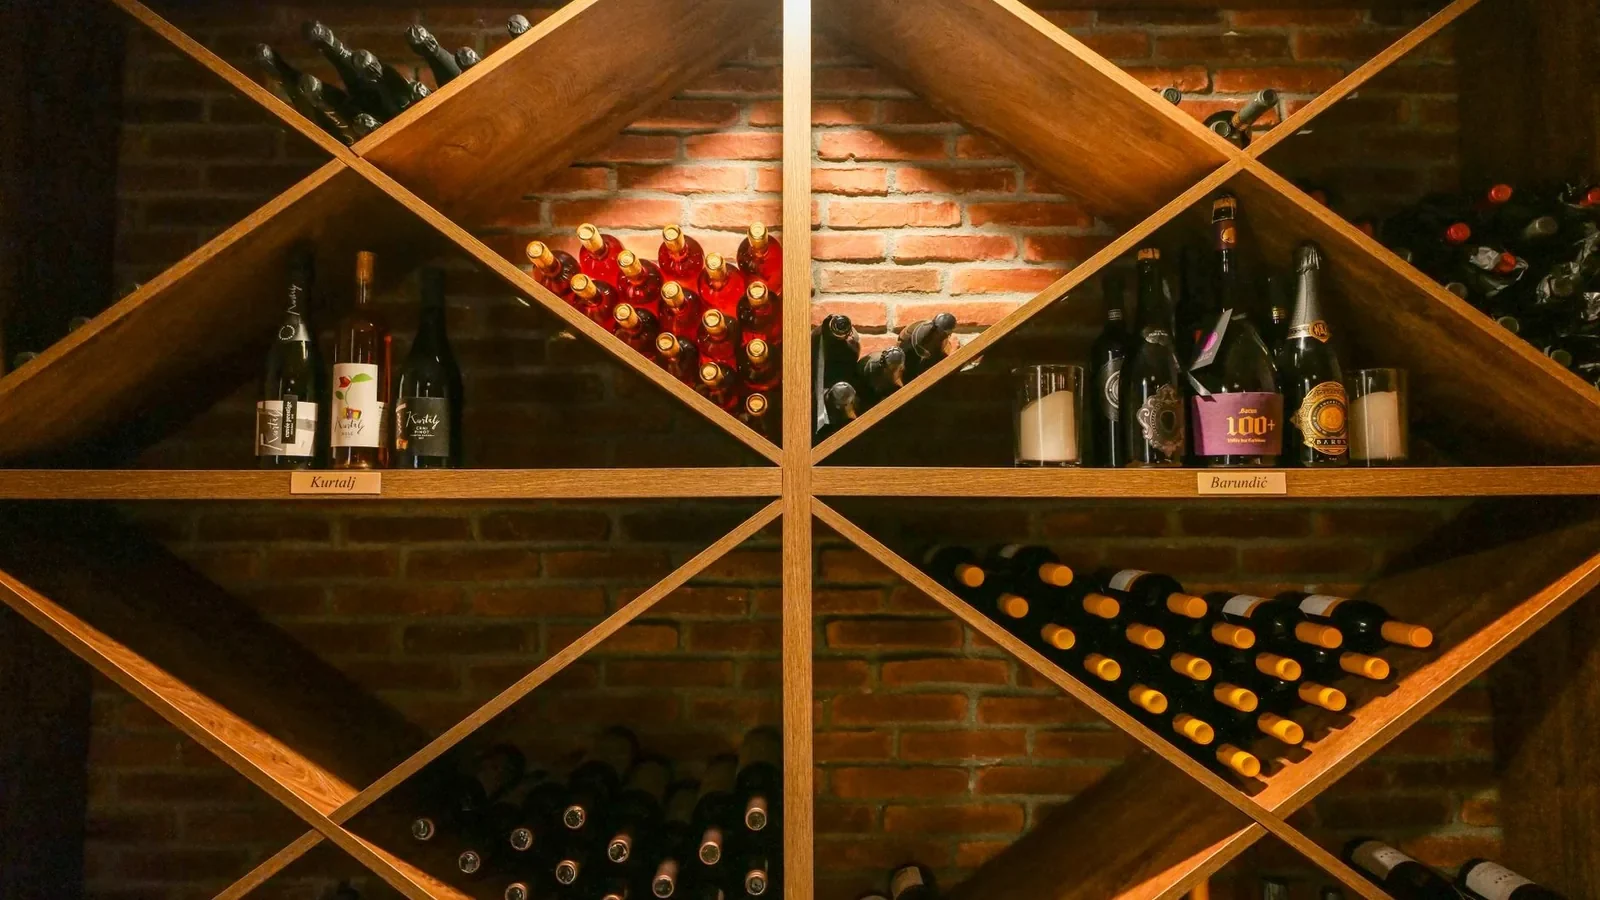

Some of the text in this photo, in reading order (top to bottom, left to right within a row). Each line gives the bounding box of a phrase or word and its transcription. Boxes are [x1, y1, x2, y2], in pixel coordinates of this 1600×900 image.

[285, 401, 293, 423] prestige
[1226, 415, 1276, 437] 100+
[310, 475, 357, 491] Kurtalj
[1210, 475, 1268, 489] Barundić
